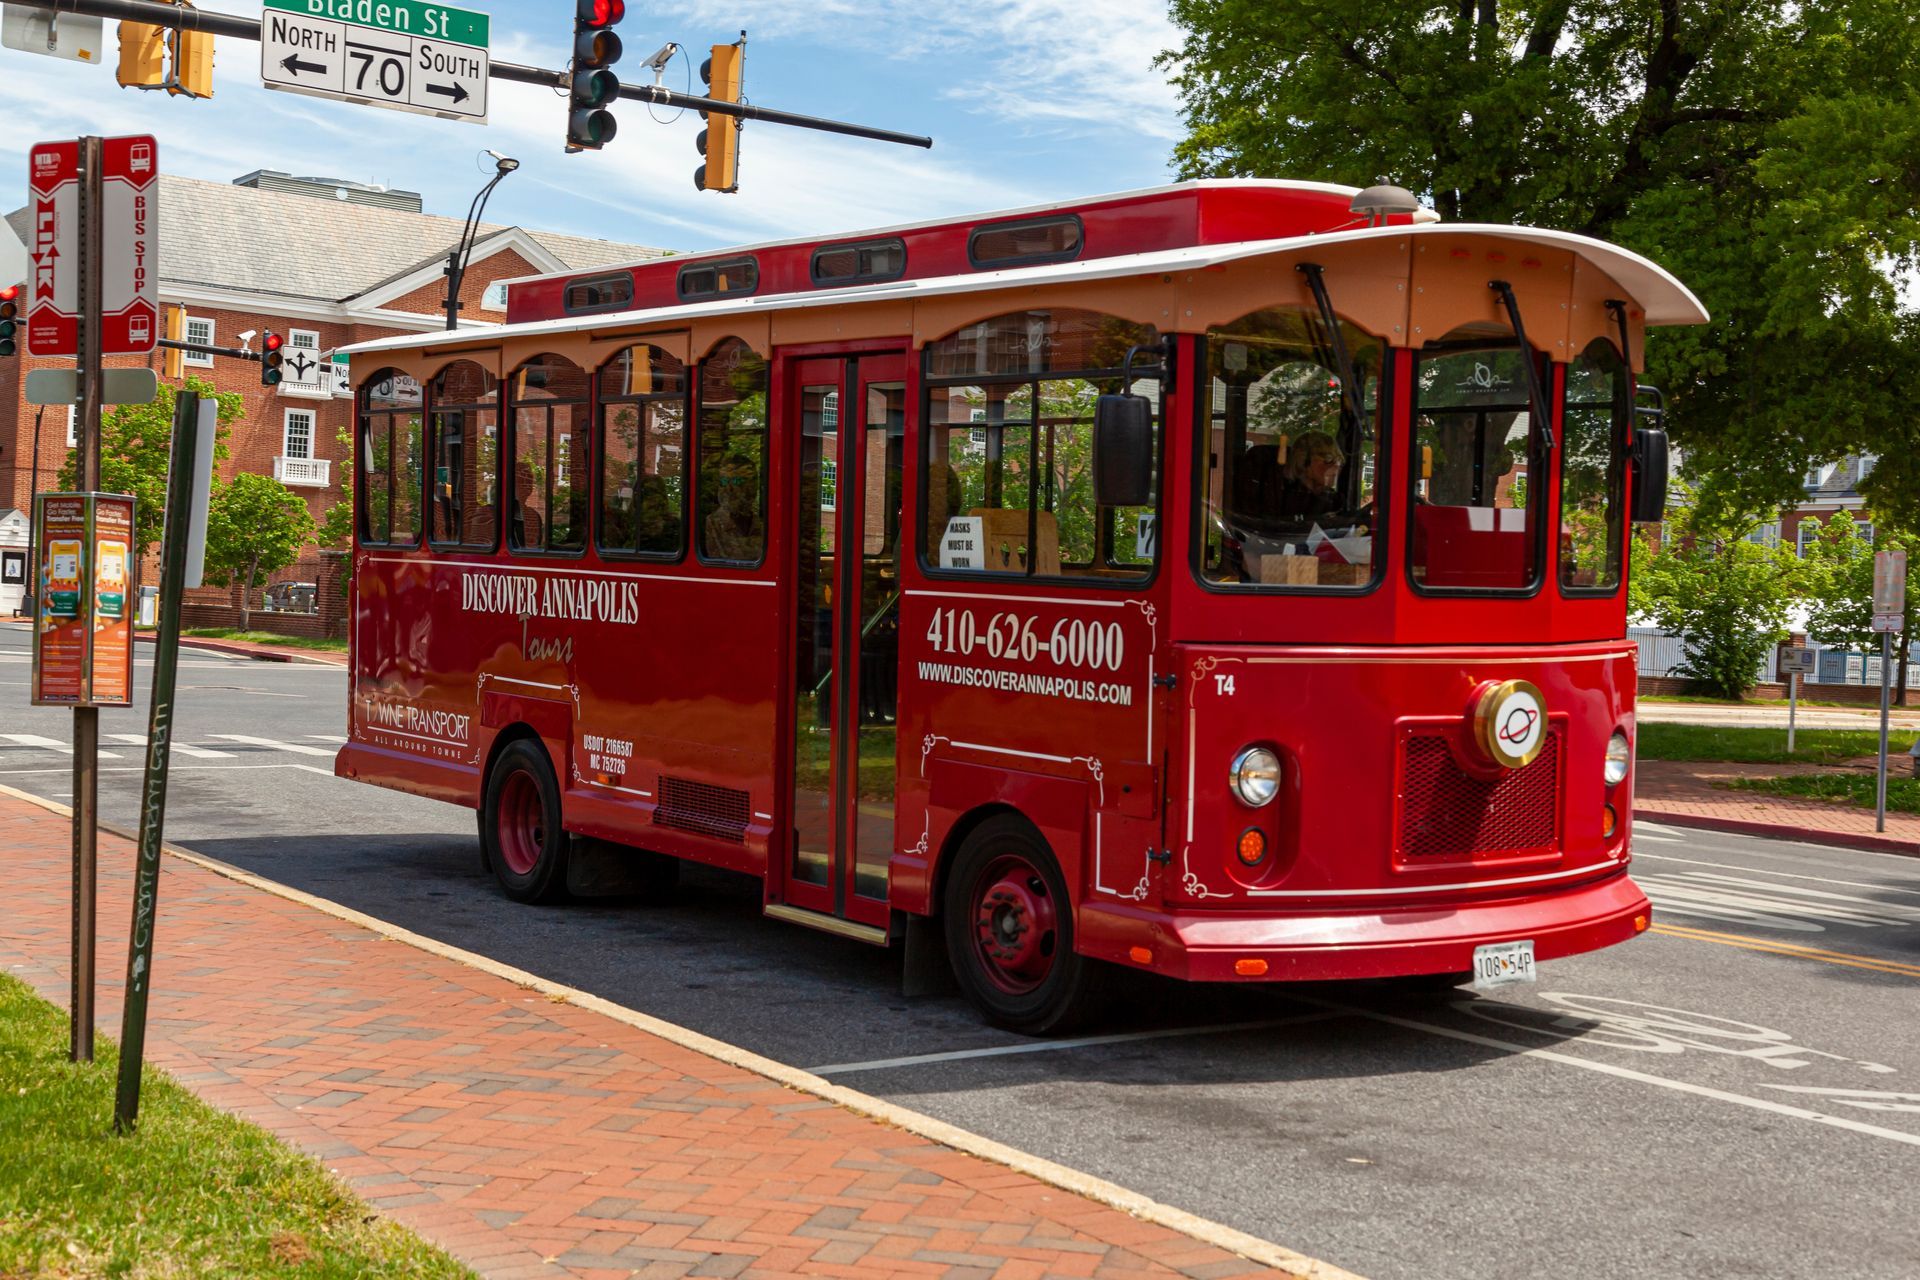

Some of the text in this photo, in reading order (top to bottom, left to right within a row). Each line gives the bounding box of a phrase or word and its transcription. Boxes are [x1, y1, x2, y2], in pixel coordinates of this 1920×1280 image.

[272, 16, 336, 53] NORTH
[423, 8, 449, 37] St
[349, 51, 405, 96] 70
[419, 45, 480, 79] SOUTH
[134, 196, 145, 293] BUS STOP
[335, 366, 350, 378] NO
[950, 523, 970, 533] MASKS
[948, 540, 973, 550] MUST BE
[952, 557, 970, 568] WORN
[462, 573, 639, 625] DISCOVER ANNAPOLIS
[518, 612, 574, 664] Tours
[926, 607, 1124, 672] 410-626-6000
[918, 661, 1132, 706] WWW.DISCOVERANNAPOLIS.COM
[1214, 674, 1235, 696] T4
[366, 700, 470, 740] TWNE TRANSPORT
[374, 735, 388, 745] ALL
[393, 738, 427, 752] AROUND
[583, 734, 633, 757] USDOT 2166587
[590, 753, 626, 774] MC 752726
